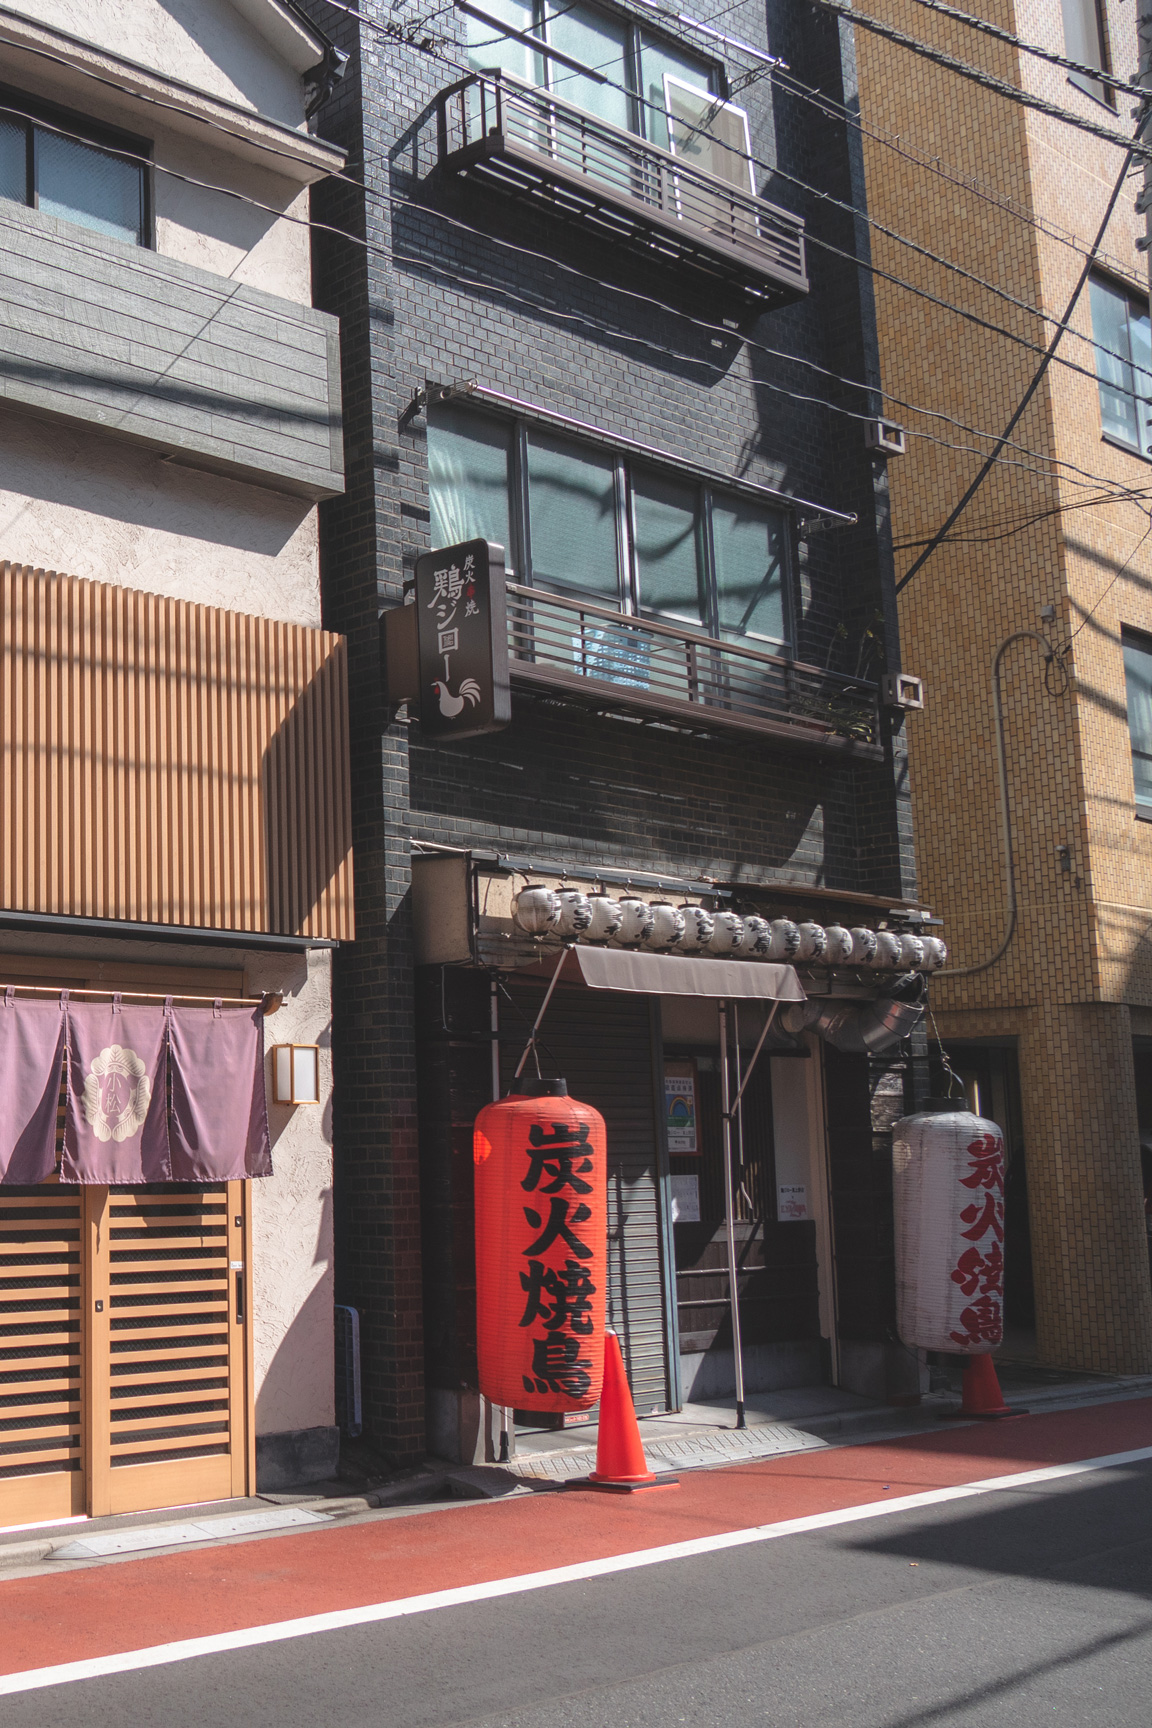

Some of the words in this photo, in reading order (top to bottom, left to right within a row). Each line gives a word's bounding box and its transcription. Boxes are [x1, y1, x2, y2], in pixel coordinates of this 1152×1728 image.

[105, 1073, 122, 1113] 小松
[519, 1121, 597, 1399] 炭火焼鳥
